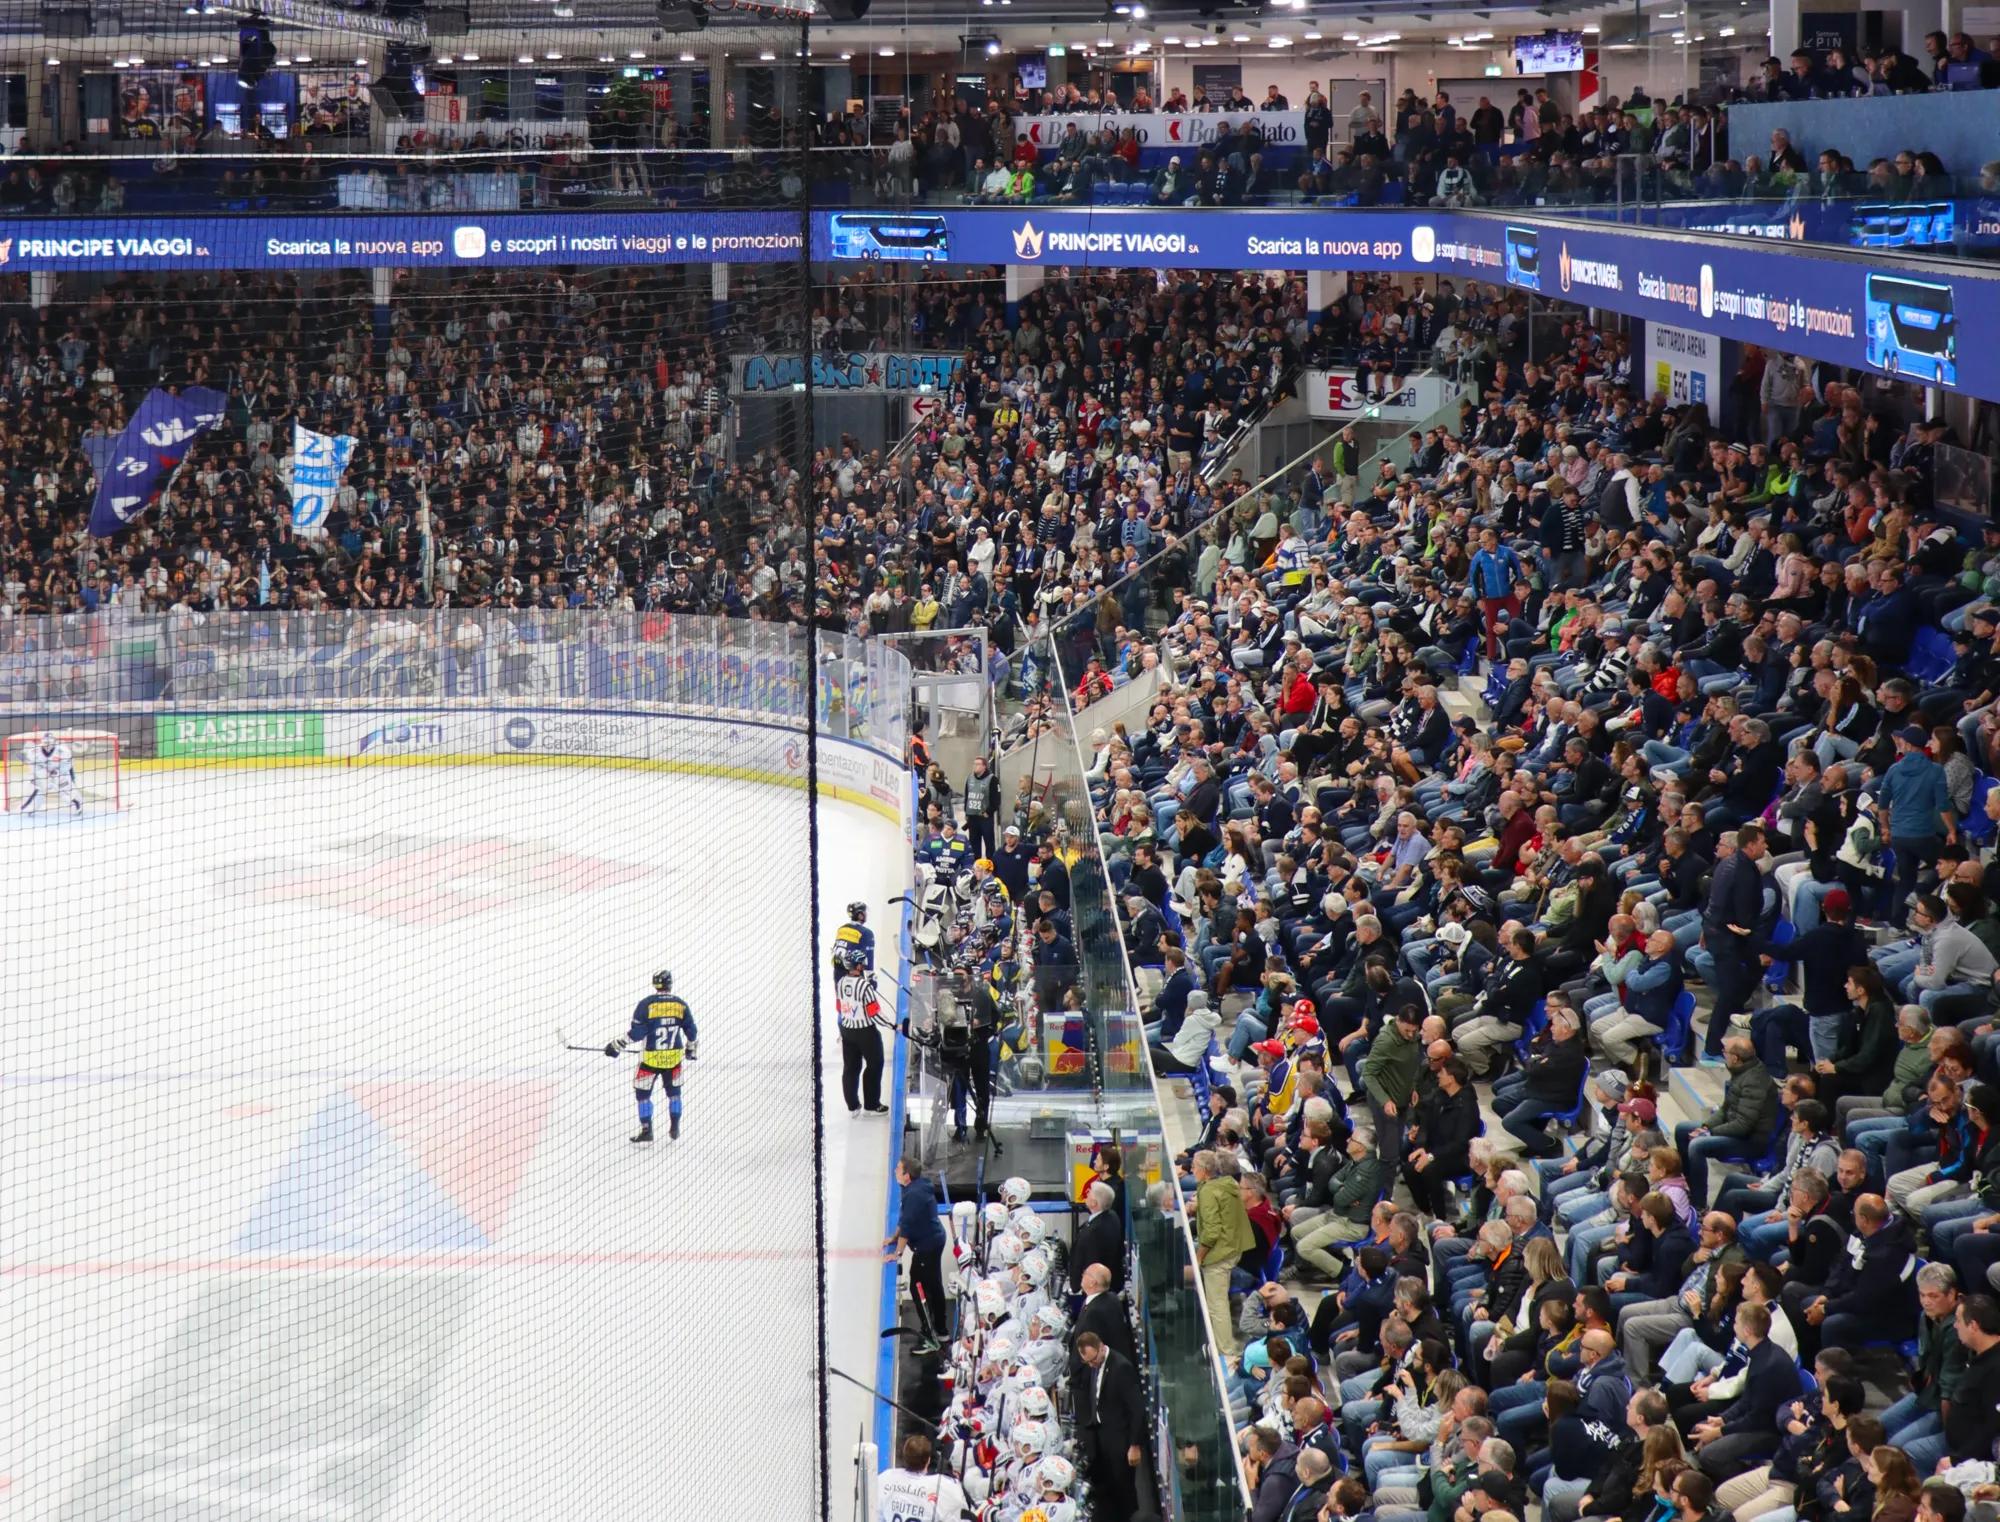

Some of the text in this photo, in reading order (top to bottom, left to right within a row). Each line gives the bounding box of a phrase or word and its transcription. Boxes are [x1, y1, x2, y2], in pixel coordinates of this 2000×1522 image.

[1816, 37, 1842, 48] PIN
[19, 239, 114, 258] PRINCIPE
[117, 238, 193, 257] VIAGGI
[267, 238, 444, 257] Scarica la nuova app
[491, 241, 502, 252] e
[507, 235, 558, 256] scopri
[561, 235, 566, 251] i
[571, 234, 617, 251] nostri
[622, 234, 672, 254] viaggi
[676, 238, 687, 250] e
[692, 233, 707, 250] le
[1049, 233, 1123, 252] PRINCIPE
[1124, 234, 1185, 253] VIAGGI
[1247, 236, 1402, 260] Scarica la nuova app
[1638, 271, 1660, 300] Scarica
[1685, 285, 1698, 312] app
[1714, 290, 1720, 311] e
[1720, 288, 1741, 321] scopri
[1745, 292, 1766, 320] nostri
[1766, 294, 1789, 332] viaggi
[1789, 302, 1796, 327] e
[1797, 298, 1805, 329] le
[1656, 327, 1707, 359] GOTTARDO ARENA
[177, 718, 305, 743] RASELLI
[381, 724, 442, 745] LOTTI
[541, 735, 597, 751] Cavalli
[885, 764, 899, 793] Leo
[842, 1002, 858, 1017] sky
[655, 1026, 680, 1050] 27
[1076, 1144, 1094, 1154] Red
